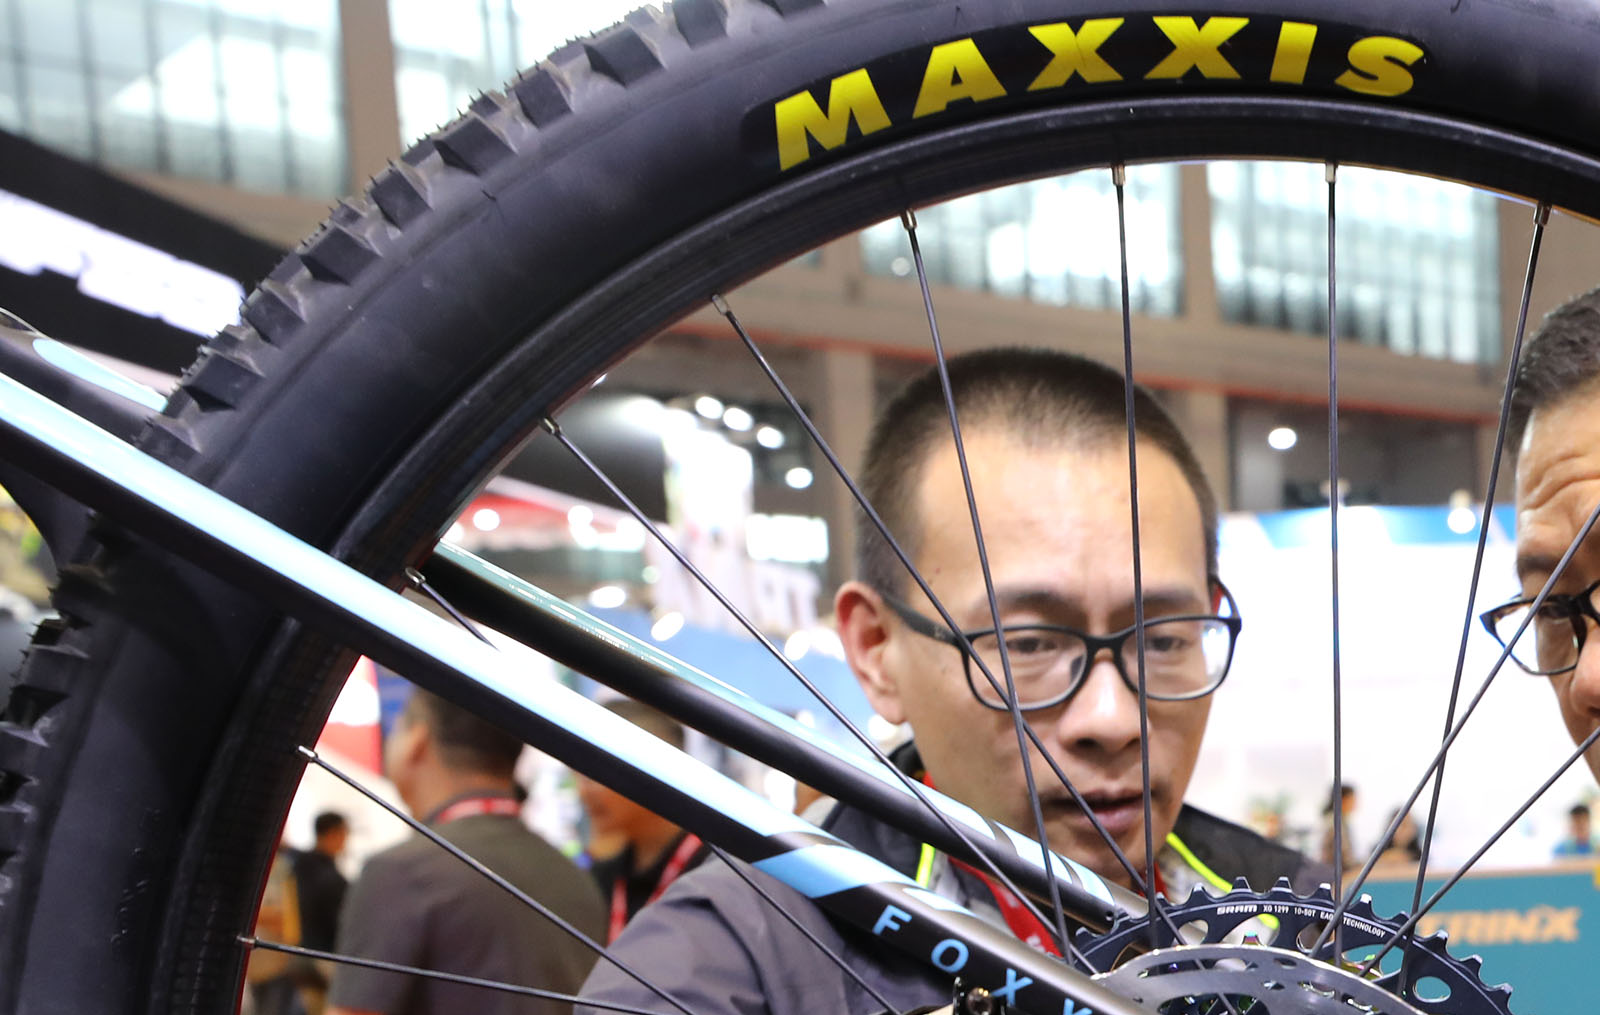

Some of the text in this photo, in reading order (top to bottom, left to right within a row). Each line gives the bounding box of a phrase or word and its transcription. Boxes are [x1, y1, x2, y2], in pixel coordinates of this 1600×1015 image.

[775, 16, 1425, 171] MAXXIS
[1217, 904, 1257, 915] SRAM
[1342, 917, 1386, 939] TECHNOLOGY
